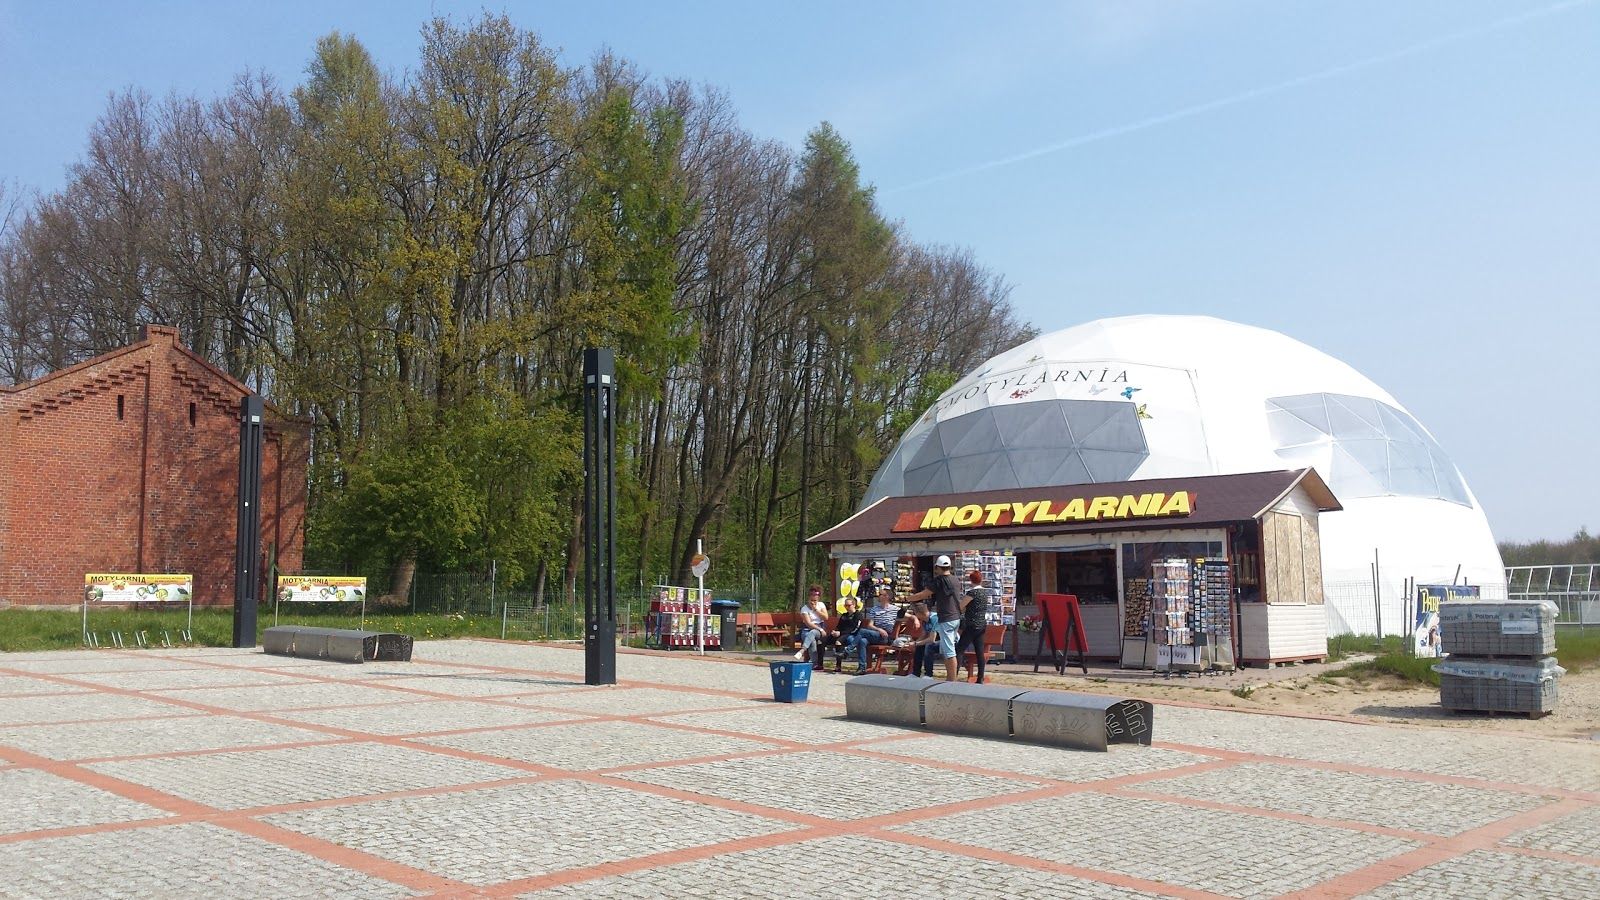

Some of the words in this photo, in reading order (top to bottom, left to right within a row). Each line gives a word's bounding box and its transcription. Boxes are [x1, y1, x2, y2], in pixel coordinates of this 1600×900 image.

[944, 366, 1129, 408] MOTYLARNIA
[920, 491, 1192, 529] MOTYLARNIA
[90, 575, 147, 584] MOTYLARNIA
